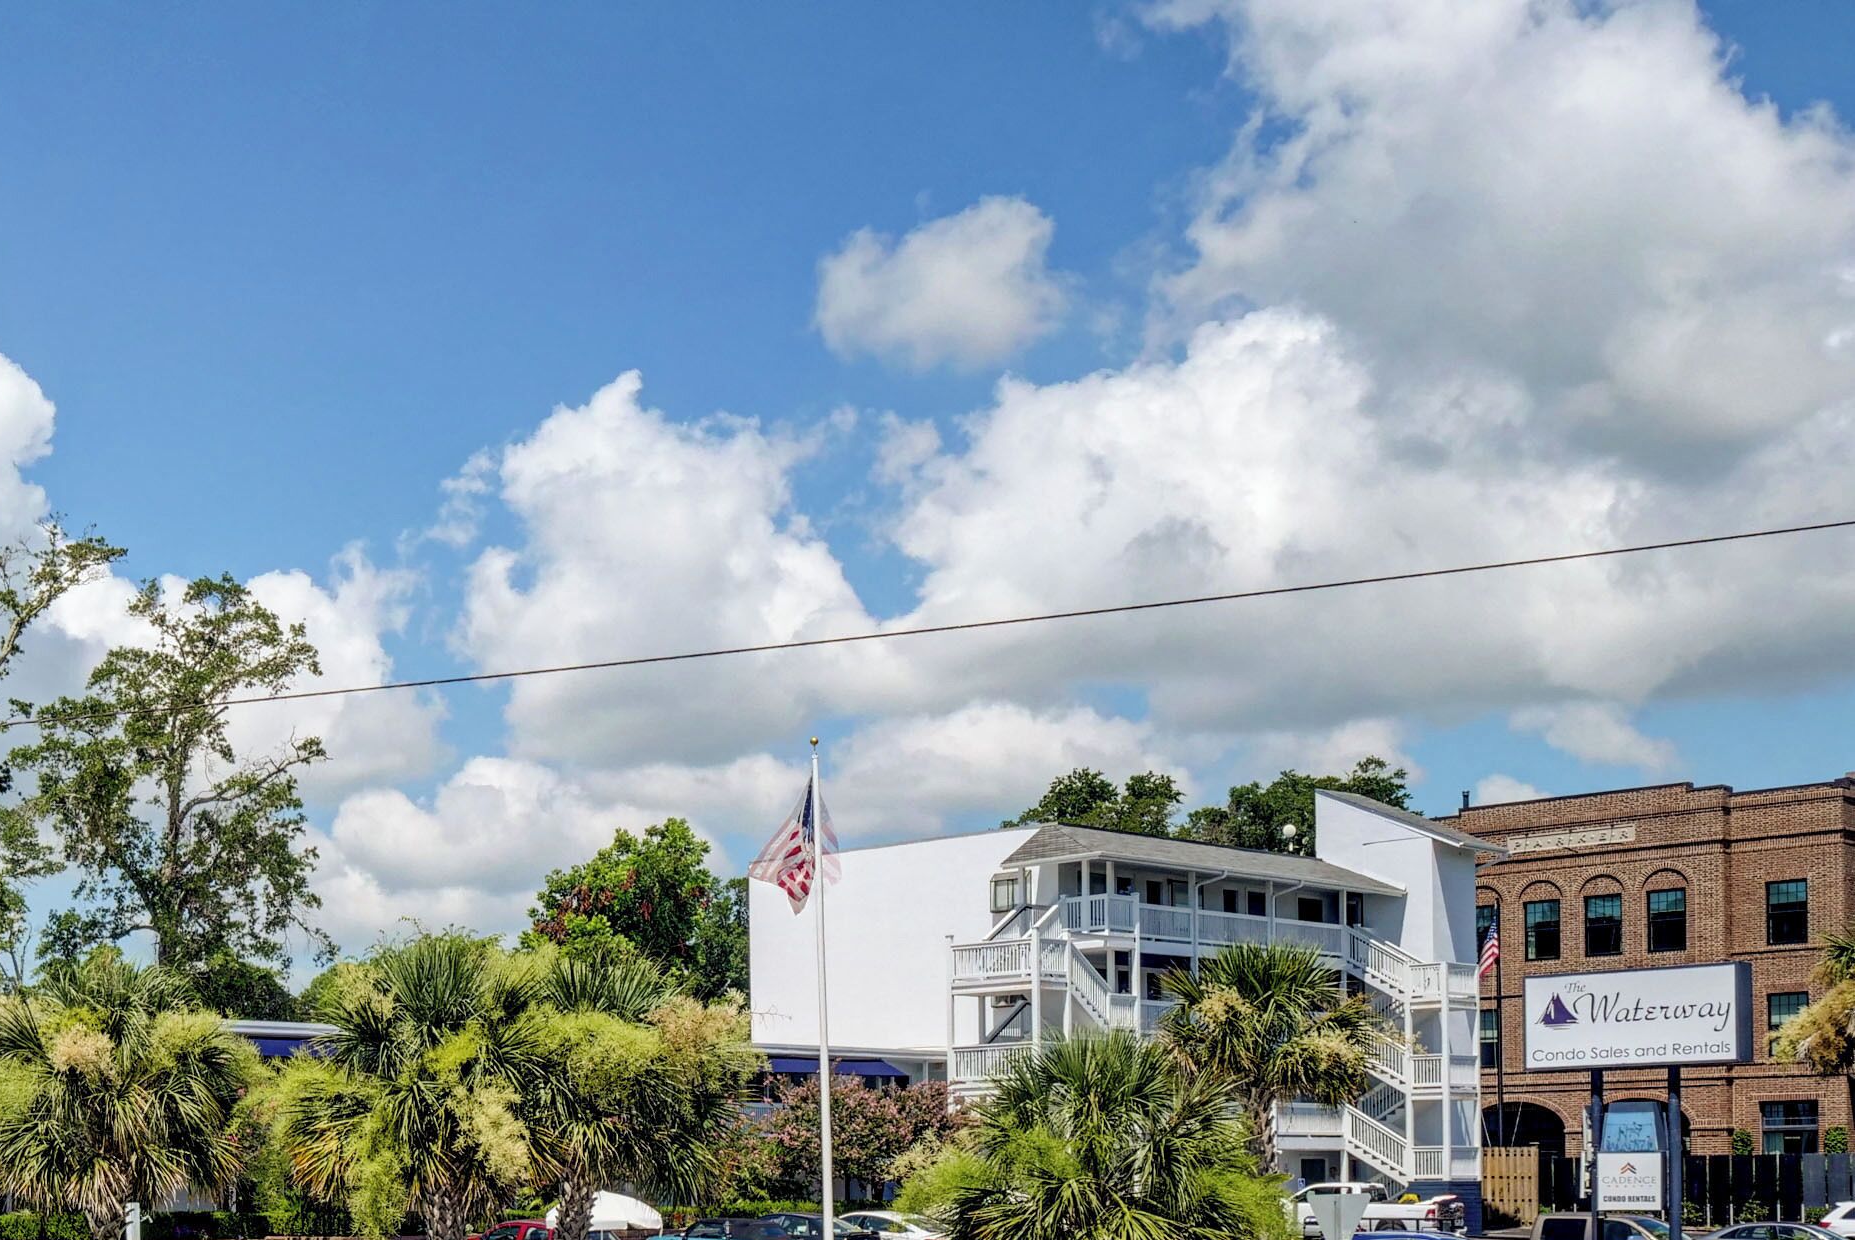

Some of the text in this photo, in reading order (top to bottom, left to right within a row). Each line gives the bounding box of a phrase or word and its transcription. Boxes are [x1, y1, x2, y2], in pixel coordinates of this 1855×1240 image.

[1564, 980, 1586, 994] The
[1572, 991, 1732, 1032] Waterway
[1532, 1041, 1731, 1062] Condo Sales and Rentals
[1601, 1176, 1657, 1184] CADENCE
